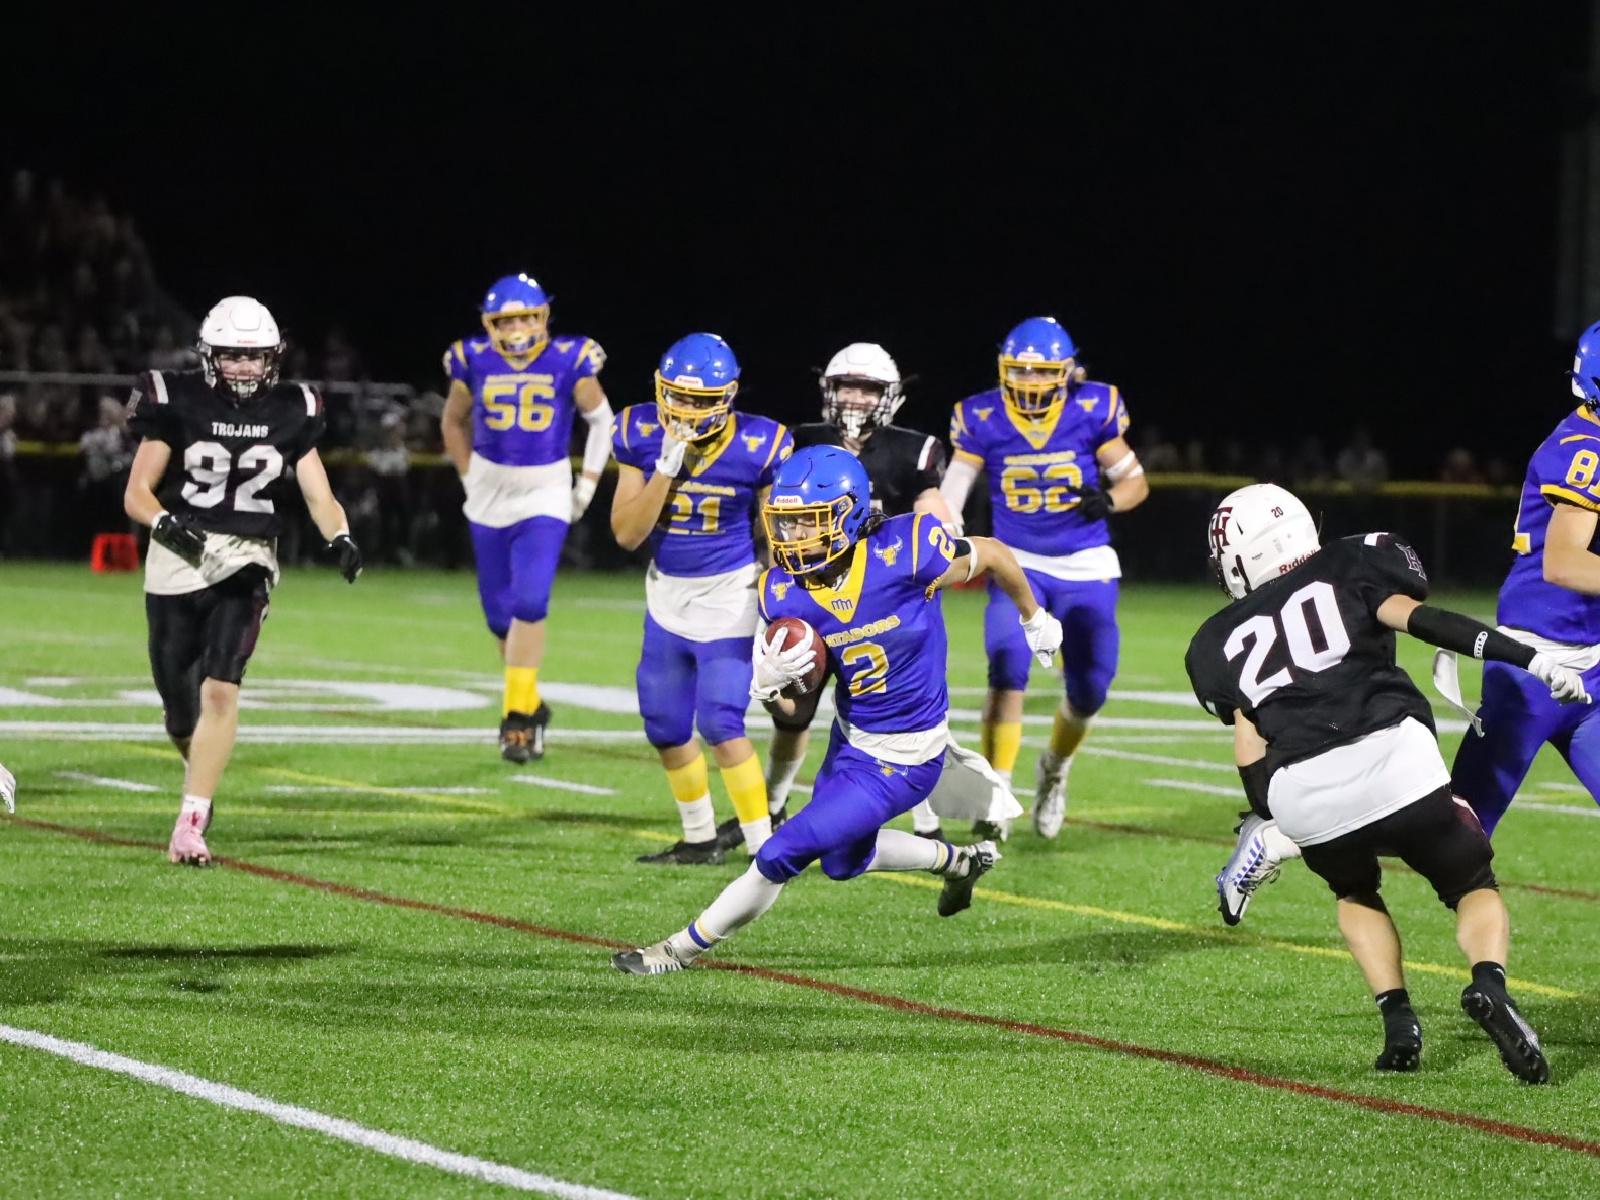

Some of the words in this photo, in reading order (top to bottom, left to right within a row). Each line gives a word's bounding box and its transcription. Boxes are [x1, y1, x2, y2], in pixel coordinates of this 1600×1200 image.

[211, 422, 269, 438] TROJANS
[482, 382, 556, 432] 56
[181, 440, 283, 514] 92
[1001, 462, 1083, 514] 62
[1566, 449, 1600, 498] 8
[668, 493, 727, 535] 21
[1271, 506, 1284, 518] 20
[928, 526, 956, 563] 2
[1223, 580, 1352, 709] 20
[840, 641, 890, 698] 2
